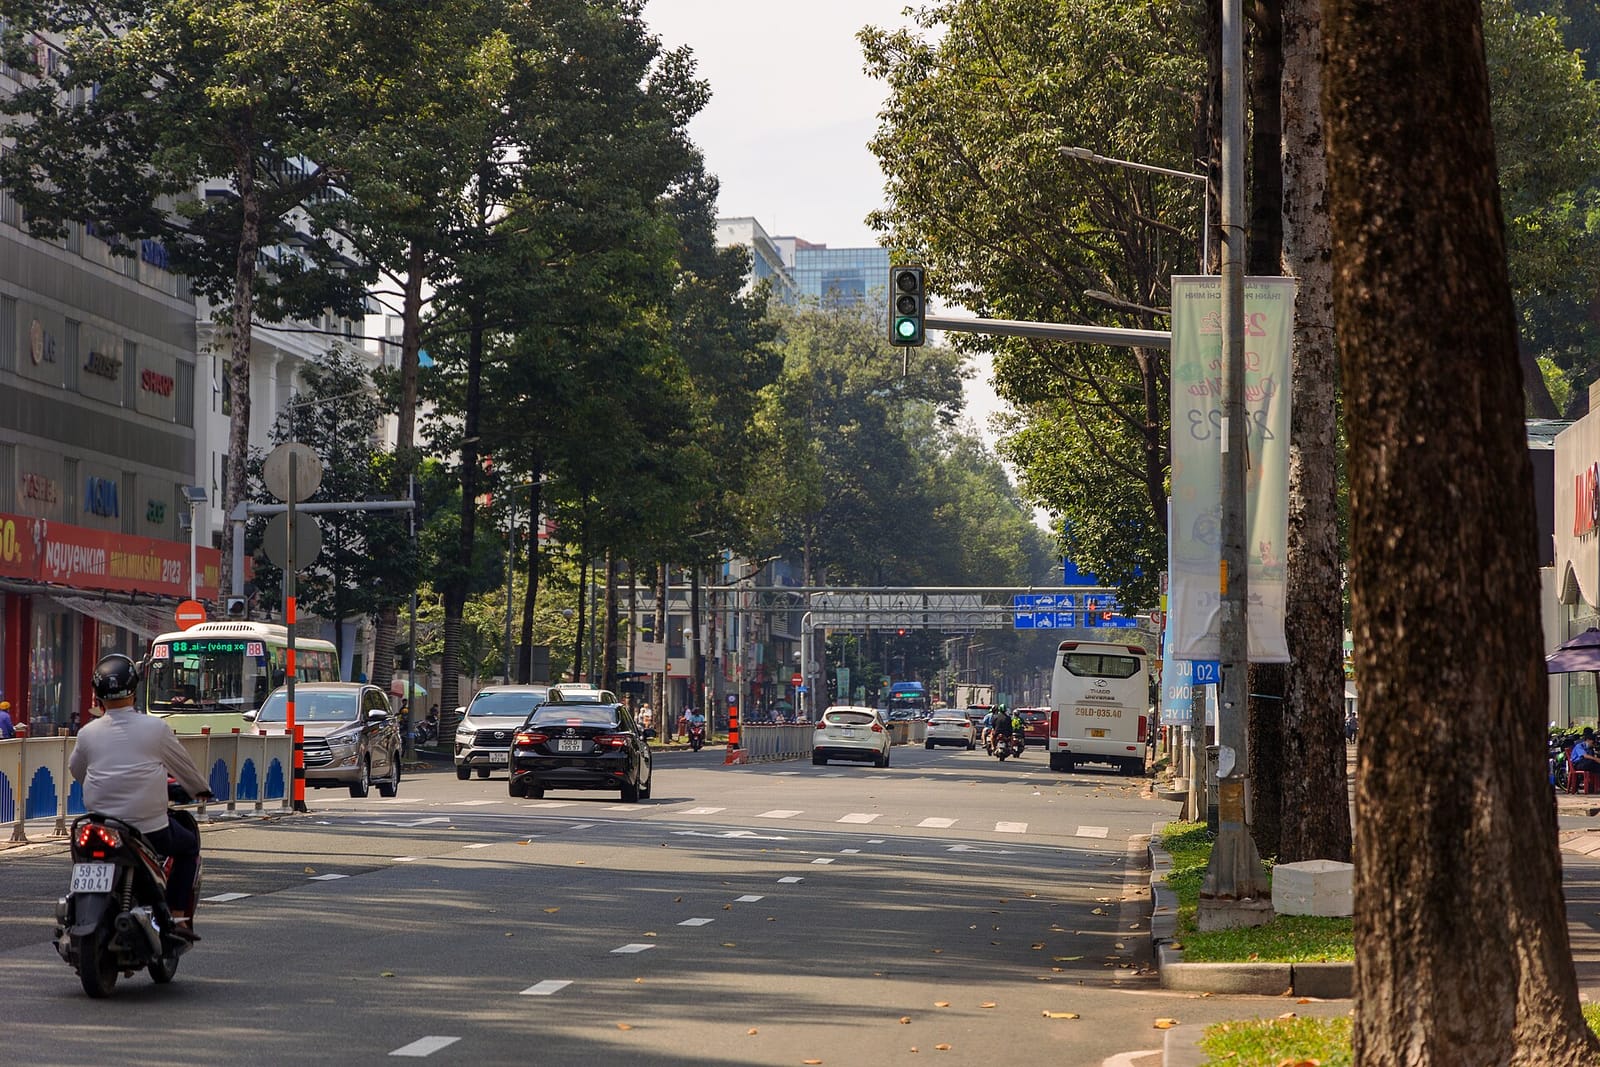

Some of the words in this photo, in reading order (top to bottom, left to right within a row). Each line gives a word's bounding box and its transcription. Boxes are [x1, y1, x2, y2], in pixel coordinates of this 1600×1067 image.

[141, 368, 174, 397] SHARP
[162, 558, 181, 585] 2023
[154, 645, 168, 658] 88
[172, 641, 188, 652] 88
[248, 642, 262, 656] 88
[1197, 663, 1213, 681] 02
[79, 865, 107, 877] 59-S1
[73, 878, 109, 890] 830.41
